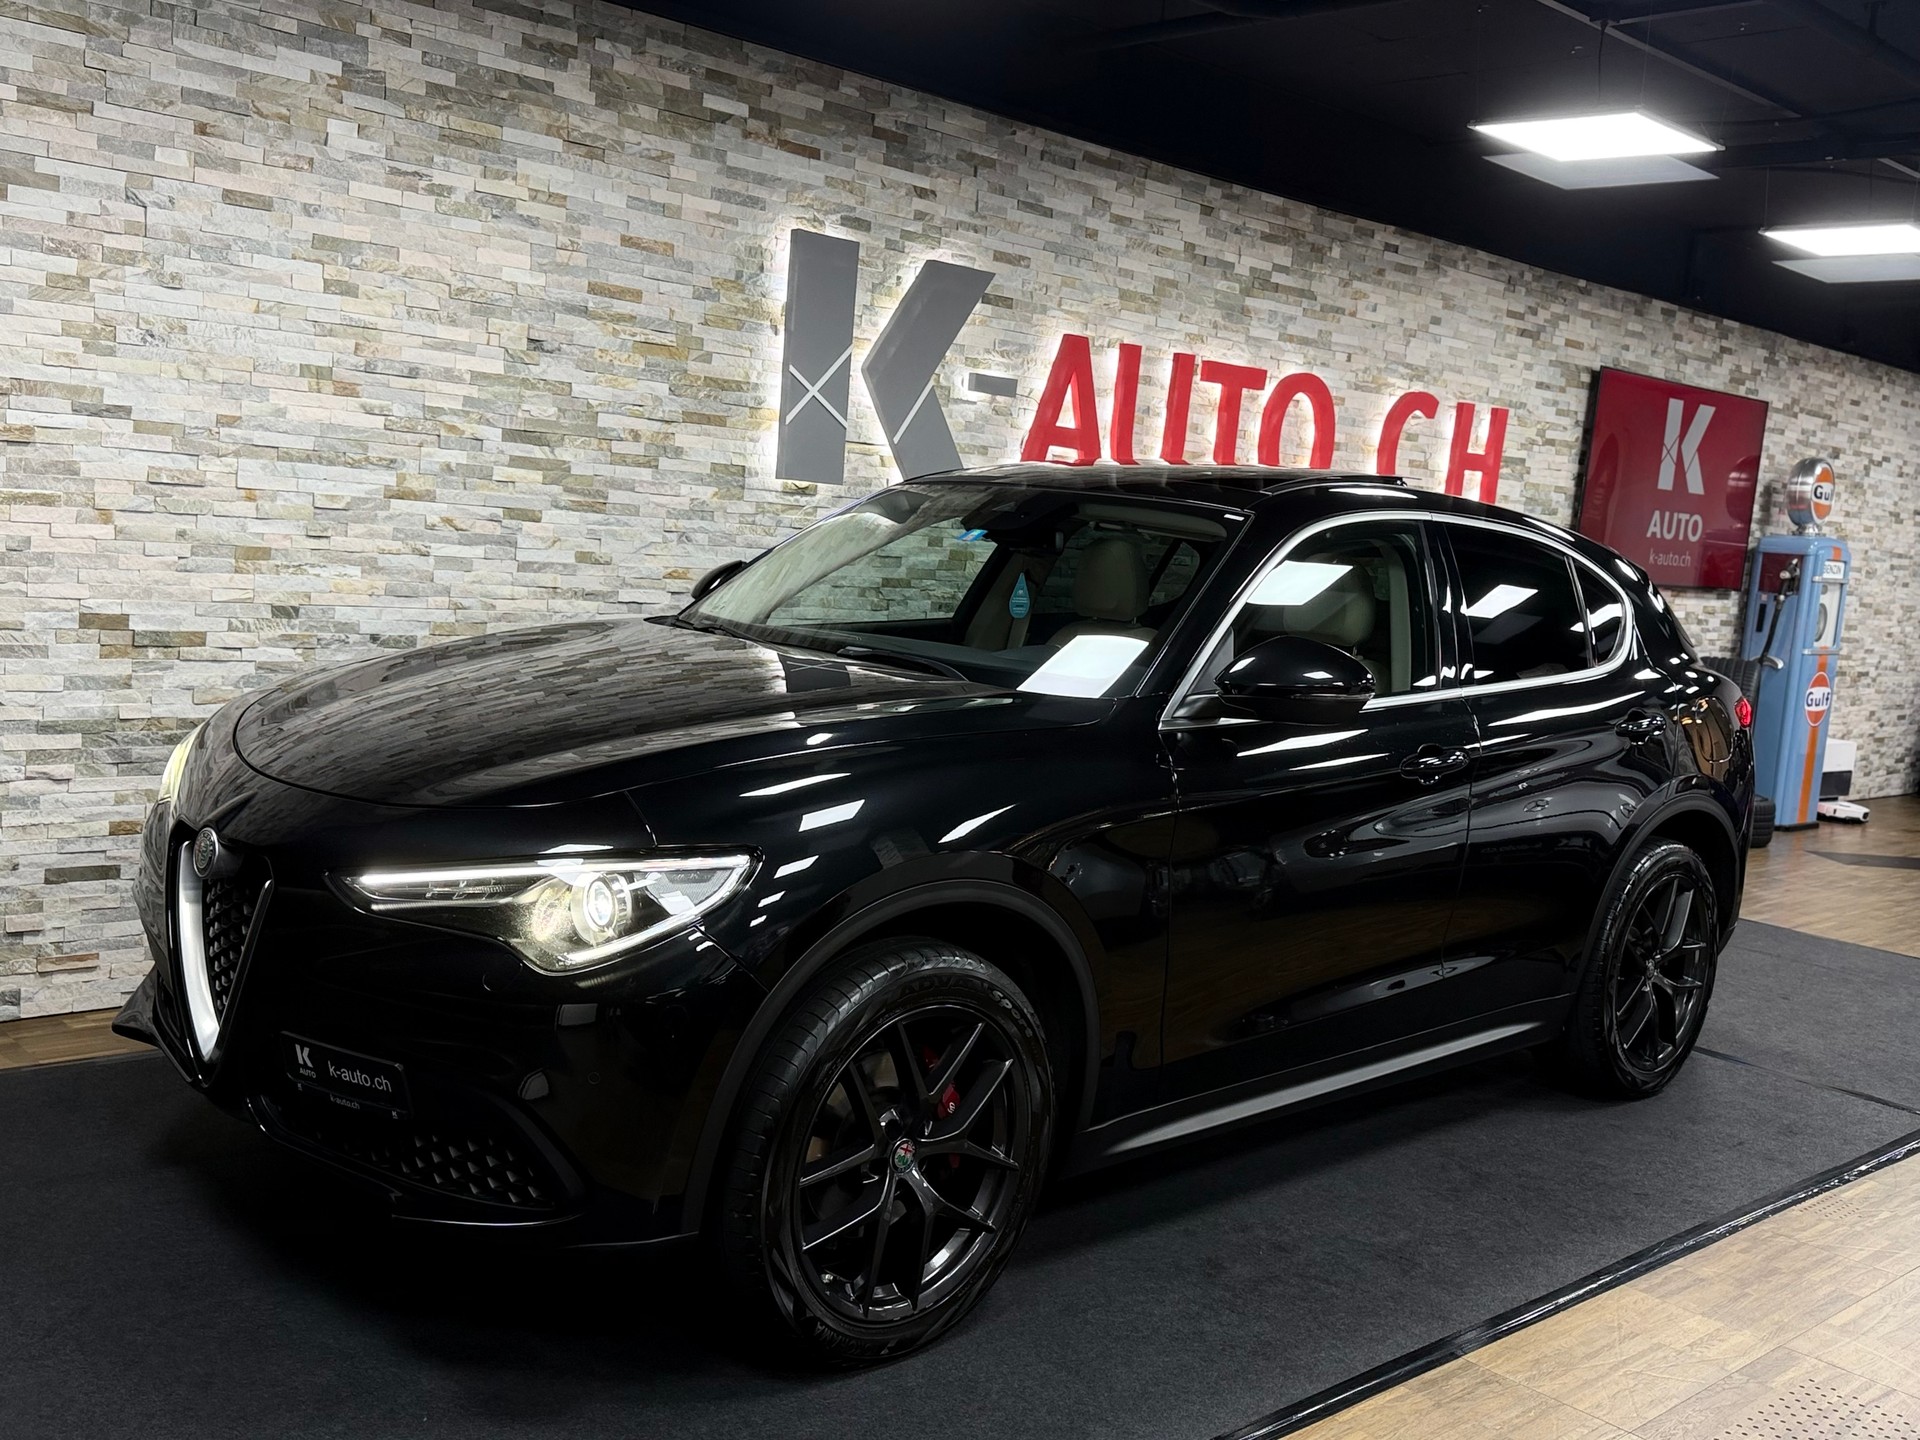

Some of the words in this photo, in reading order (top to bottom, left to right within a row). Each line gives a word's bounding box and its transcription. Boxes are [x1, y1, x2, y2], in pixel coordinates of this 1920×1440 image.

[1657, 397, 1716, 495] K
[1646, 510, 1703, 542] AUTO
[1649, 549, 1691, 567] k-auto.ch
[1806, 691, 1830, 707] Gulf
[295, 1043, 314, 1068] K
[299, 1067, 317, 1079] AUTO
[327, 1060, 393, 1093] k-auto.ch
